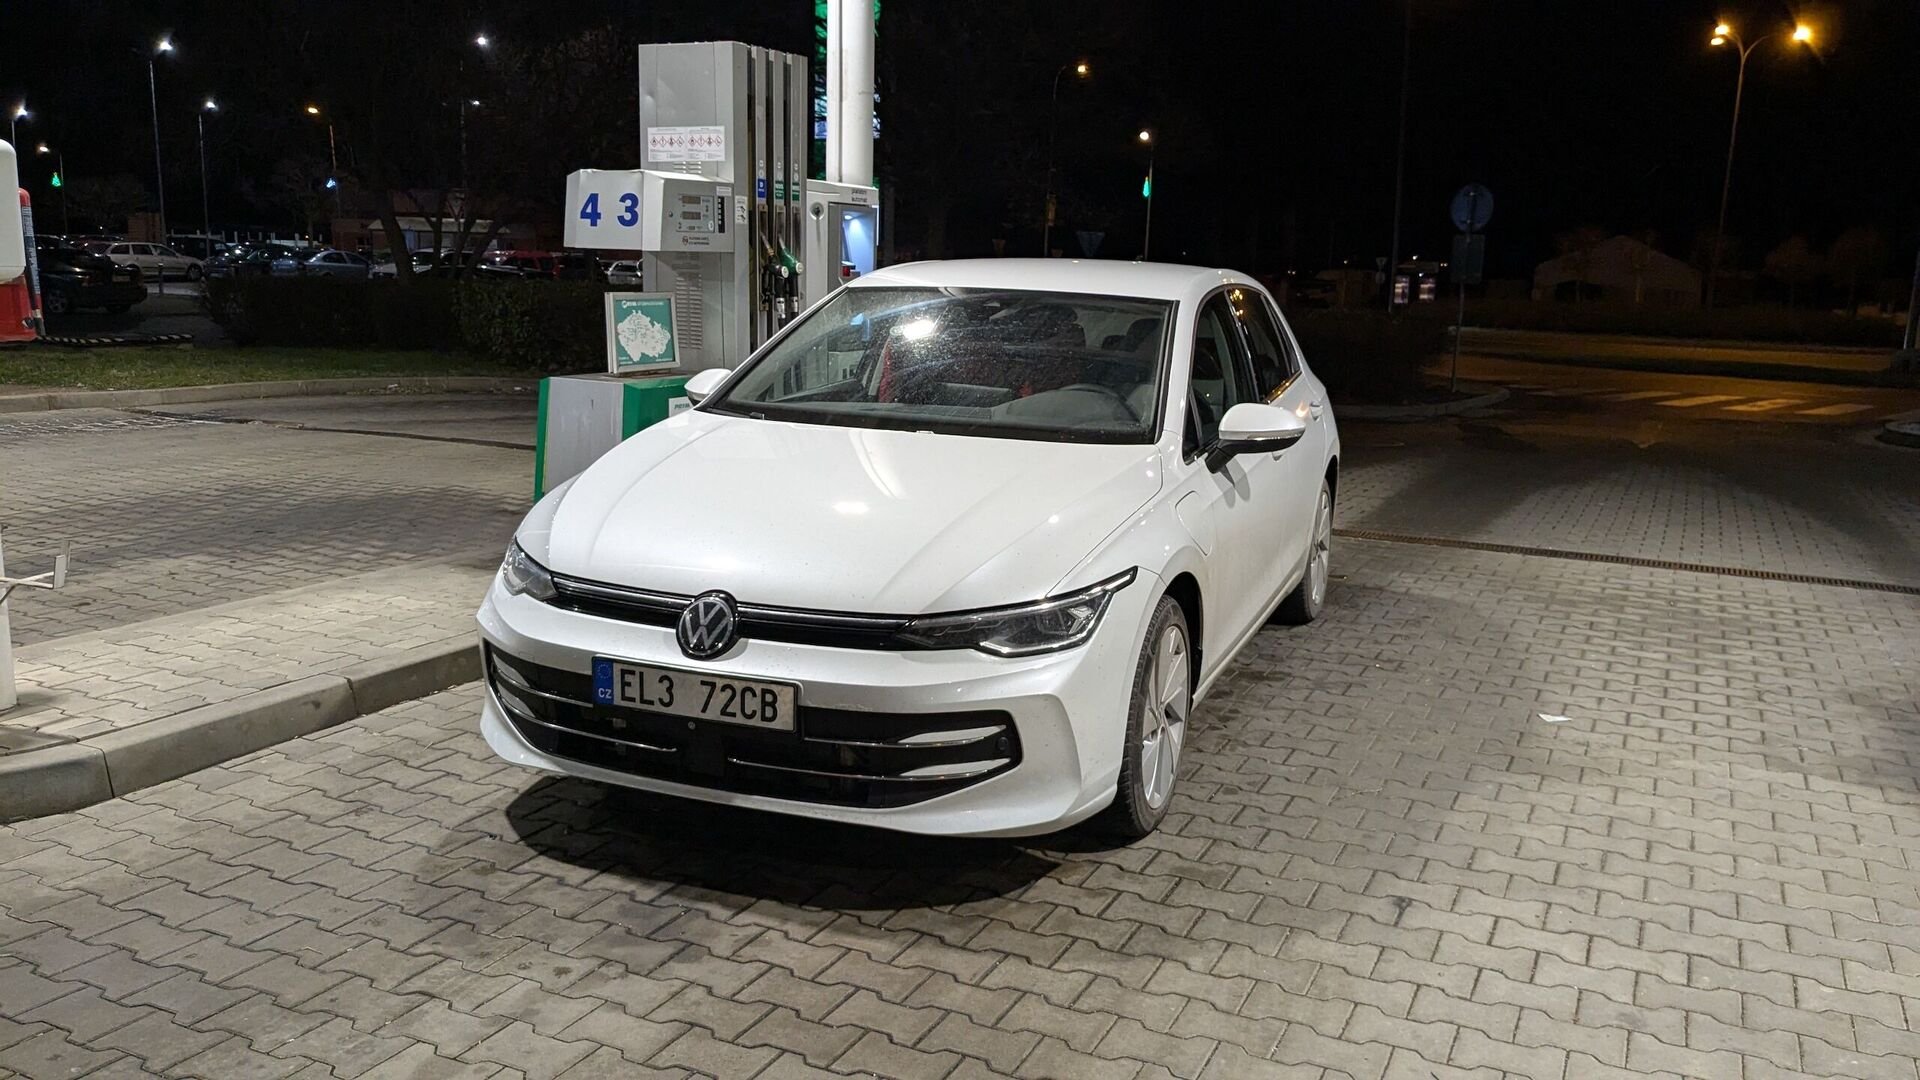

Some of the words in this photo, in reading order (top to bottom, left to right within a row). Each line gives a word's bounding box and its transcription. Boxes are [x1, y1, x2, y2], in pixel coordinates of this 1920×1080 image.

[580, 192, 602, 227] 4
[617, 192, 639, 227] 3
[598, 687, 612, 699] CZ
[620, 668, 675, 708] EL3
[700, 680, 778, 723] 72CB
